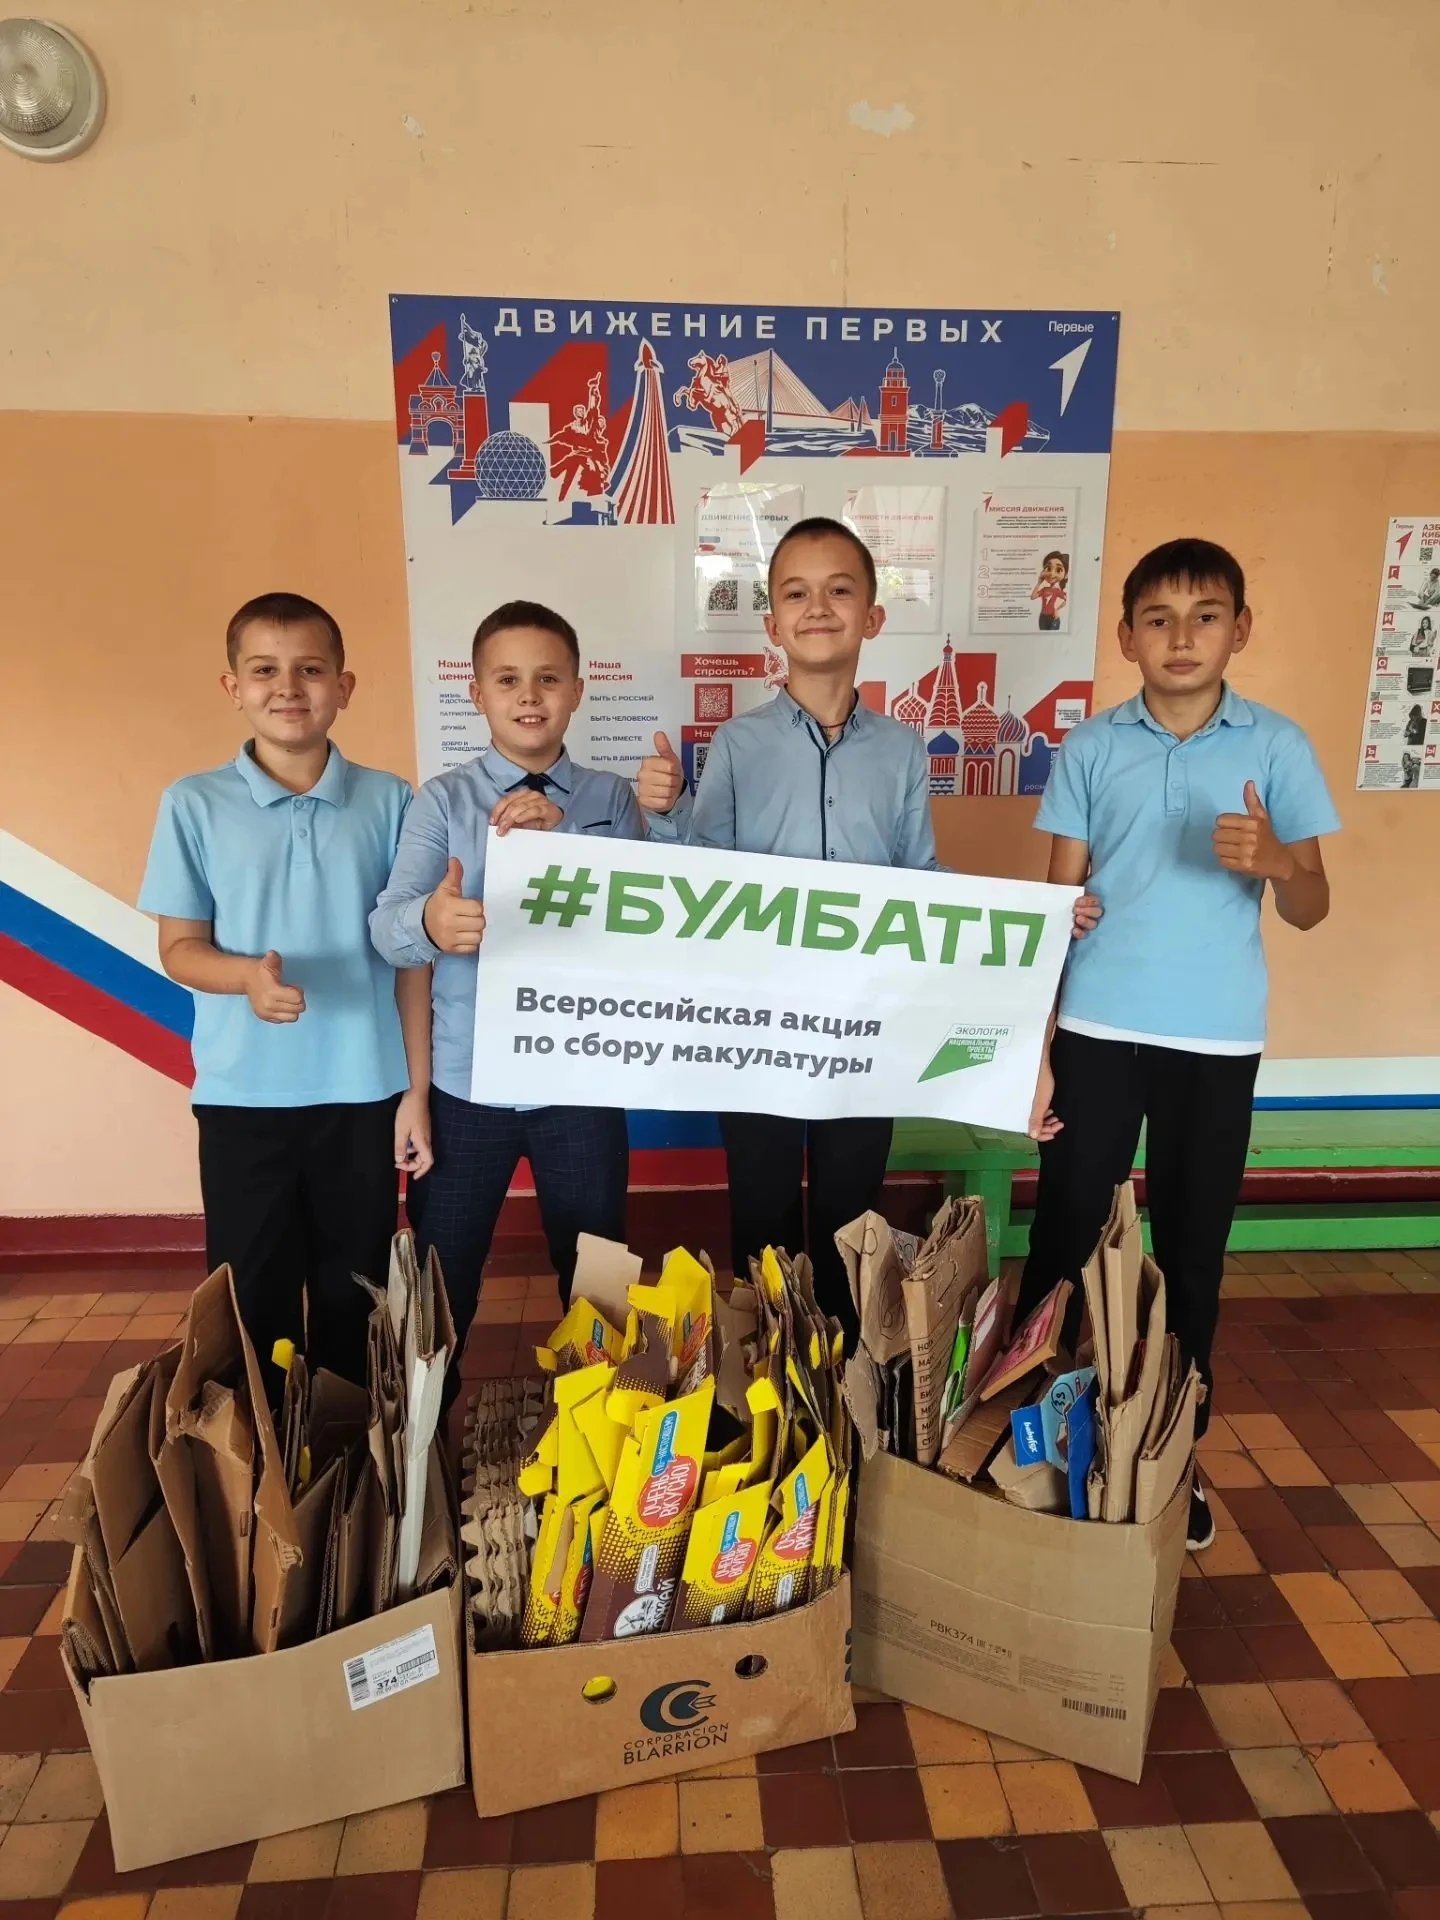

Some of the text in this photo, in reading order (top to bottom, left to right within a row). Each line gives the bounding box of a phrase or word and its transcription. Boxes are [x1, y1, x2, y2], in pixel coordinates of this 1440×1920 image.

[494, 307, 1003, 344] ДВИЖЕНИЕ ПЕРВЫХ
[1048, 320, 1095, 336] Первые
[438, 660, 472, 669] Наши
[589, 660, 622, 669] Наша
[694, 656, 739, 666] Хочешь
[438, 673, 476, 682] ценно
[589, 674, 633, 682] миссия
[694, 667, 755, 677] спросить?
[618, 694, 654, 702] РОССИЕЙ
[519, 863, 1047, 968] #БУМБАТЛ
[515, 986, 882, 1039] Всероссийская акция
[955, 1026, 1009, 1037] ЭКОЛОГИЯ
[512, 1032, 873, 1079] по сбору макулатуры
[966, 1045, 995, 1053] ПРОЕКТЫ
[969, 1052, 993, 1061] РОССИИ
[642, 1474, 670, 1517] ОЧЕНЬ
[658, 1463, 692, 1519] ВКУСНО!
[376, 1675, 398, 1690] 374
[623, 1722, 730, 1752] CORPORACION
[623, 1732, 728, 1766] BLARRION
